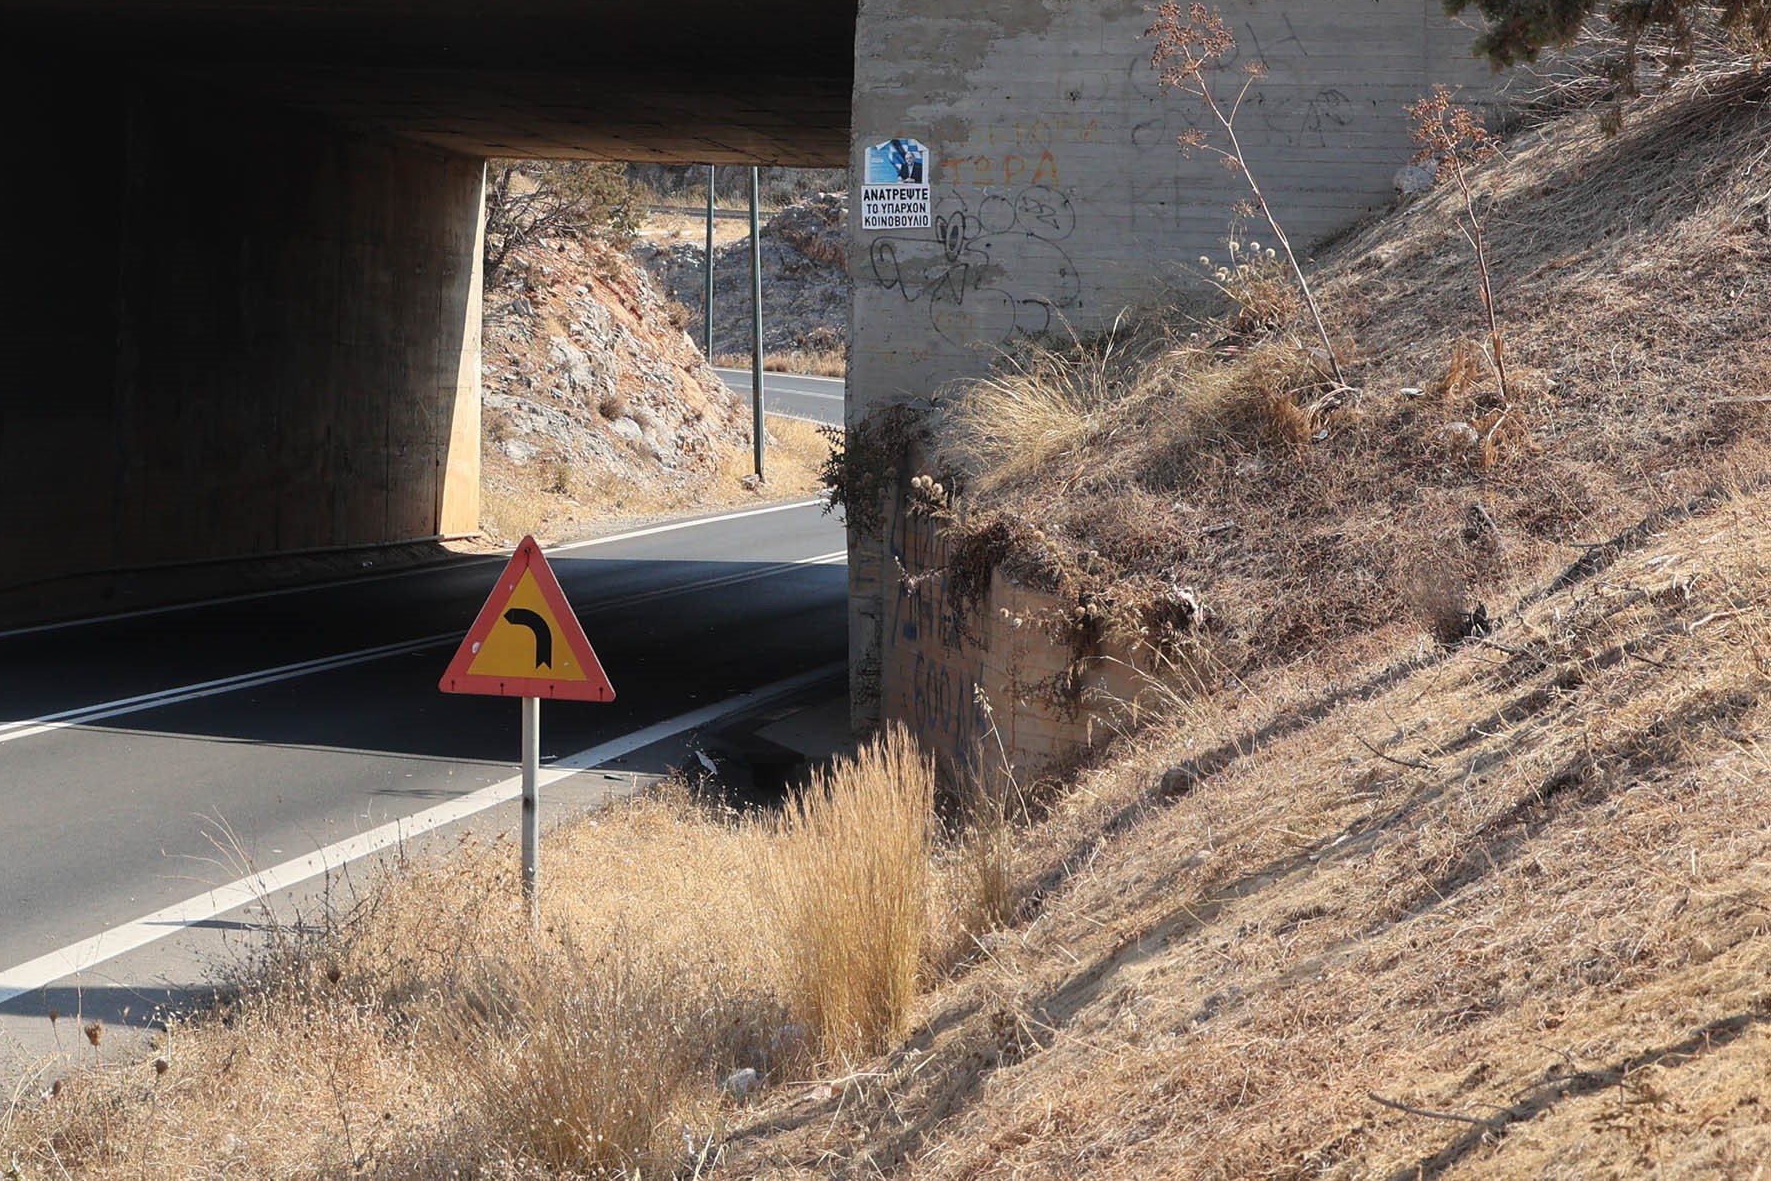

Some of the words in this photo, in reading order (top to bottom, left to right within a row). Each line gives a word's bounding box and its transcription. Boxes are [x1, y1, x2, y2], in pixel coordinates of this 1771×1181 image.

[863, 188, 929, 201] ΑΝΑΤΡΕΨΤΕ
[866, 203, 879, 214] ΤΟ
[881, 202, 926, 214] ΥΠΑΡΧΟΝ
[864, 215, 929, 227] ΚΟΙΝΟΒΟΥΛΙΟ
